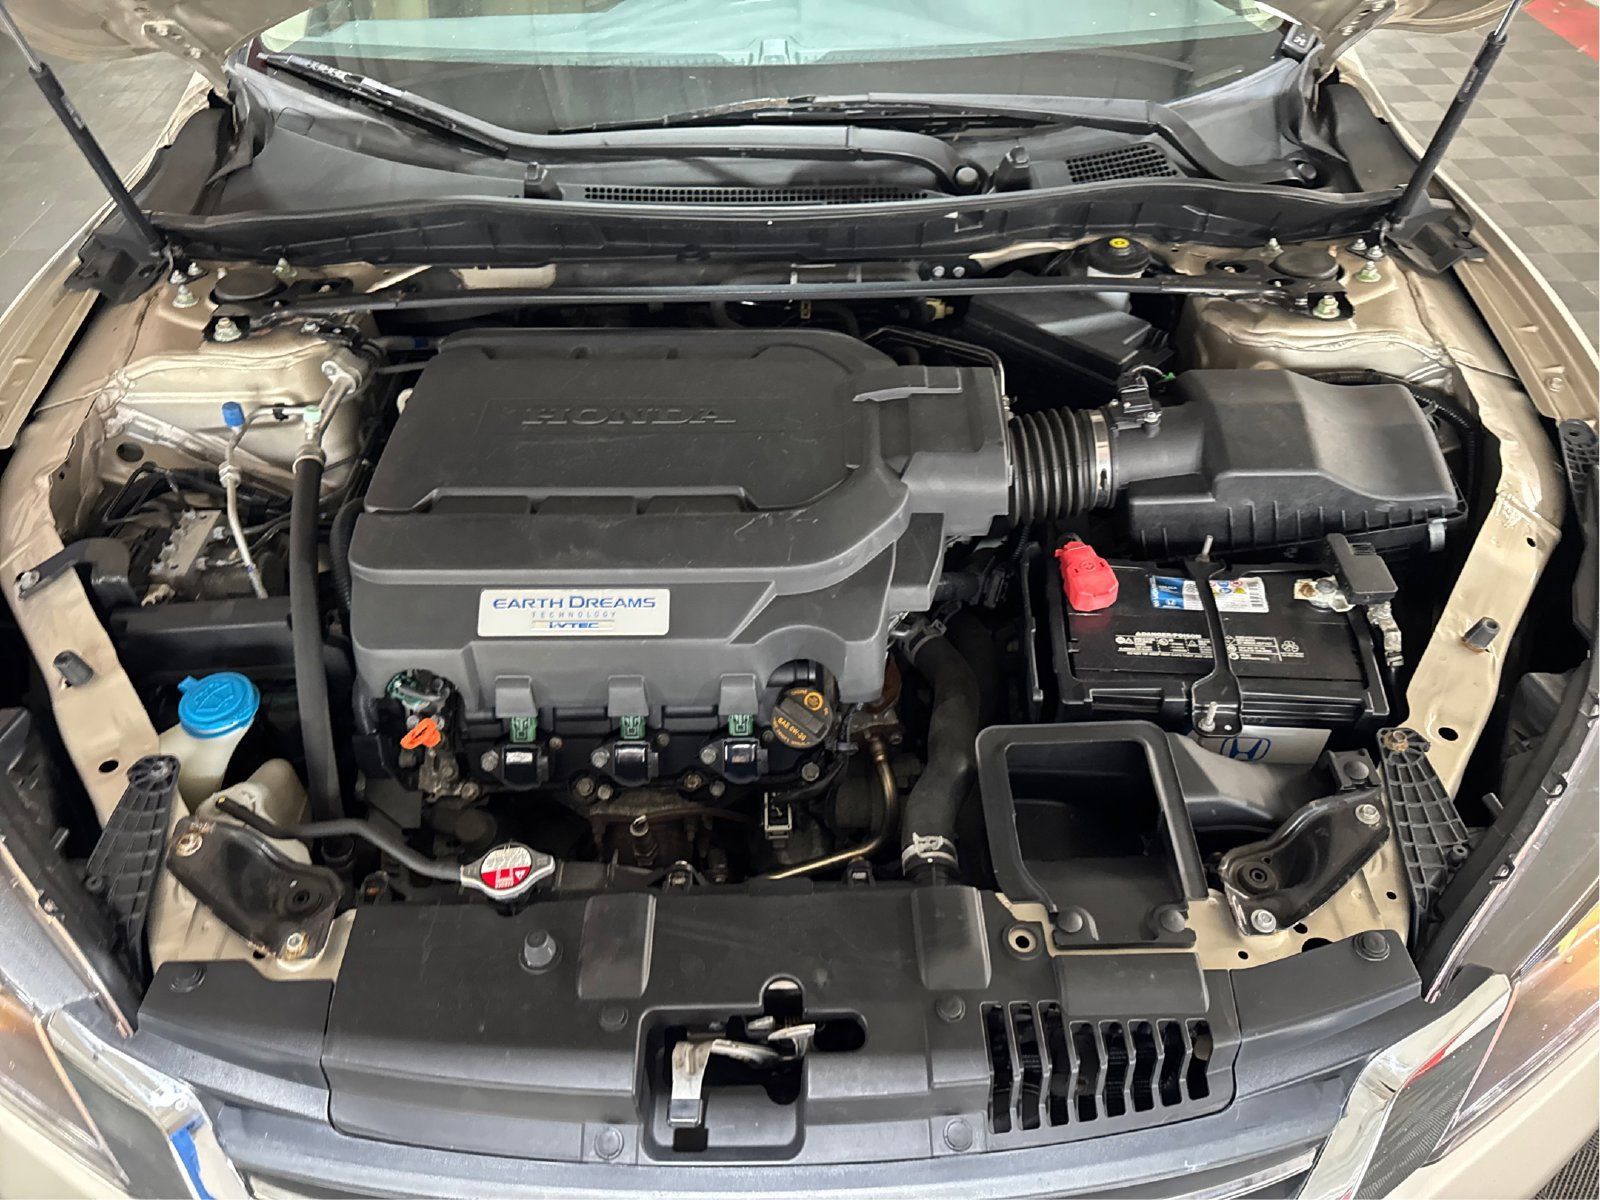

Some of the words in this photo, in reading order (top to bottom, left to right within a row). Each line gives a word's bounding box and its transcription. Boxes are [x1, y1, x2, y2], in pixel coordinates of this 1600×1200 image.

[521, 408, 737, 425] HONDA
[492, 597, 563, 609] EARTH
[568, 595, 656, 609] DREAMS
[531, 610, 617, 618] TECHNOLOGY
